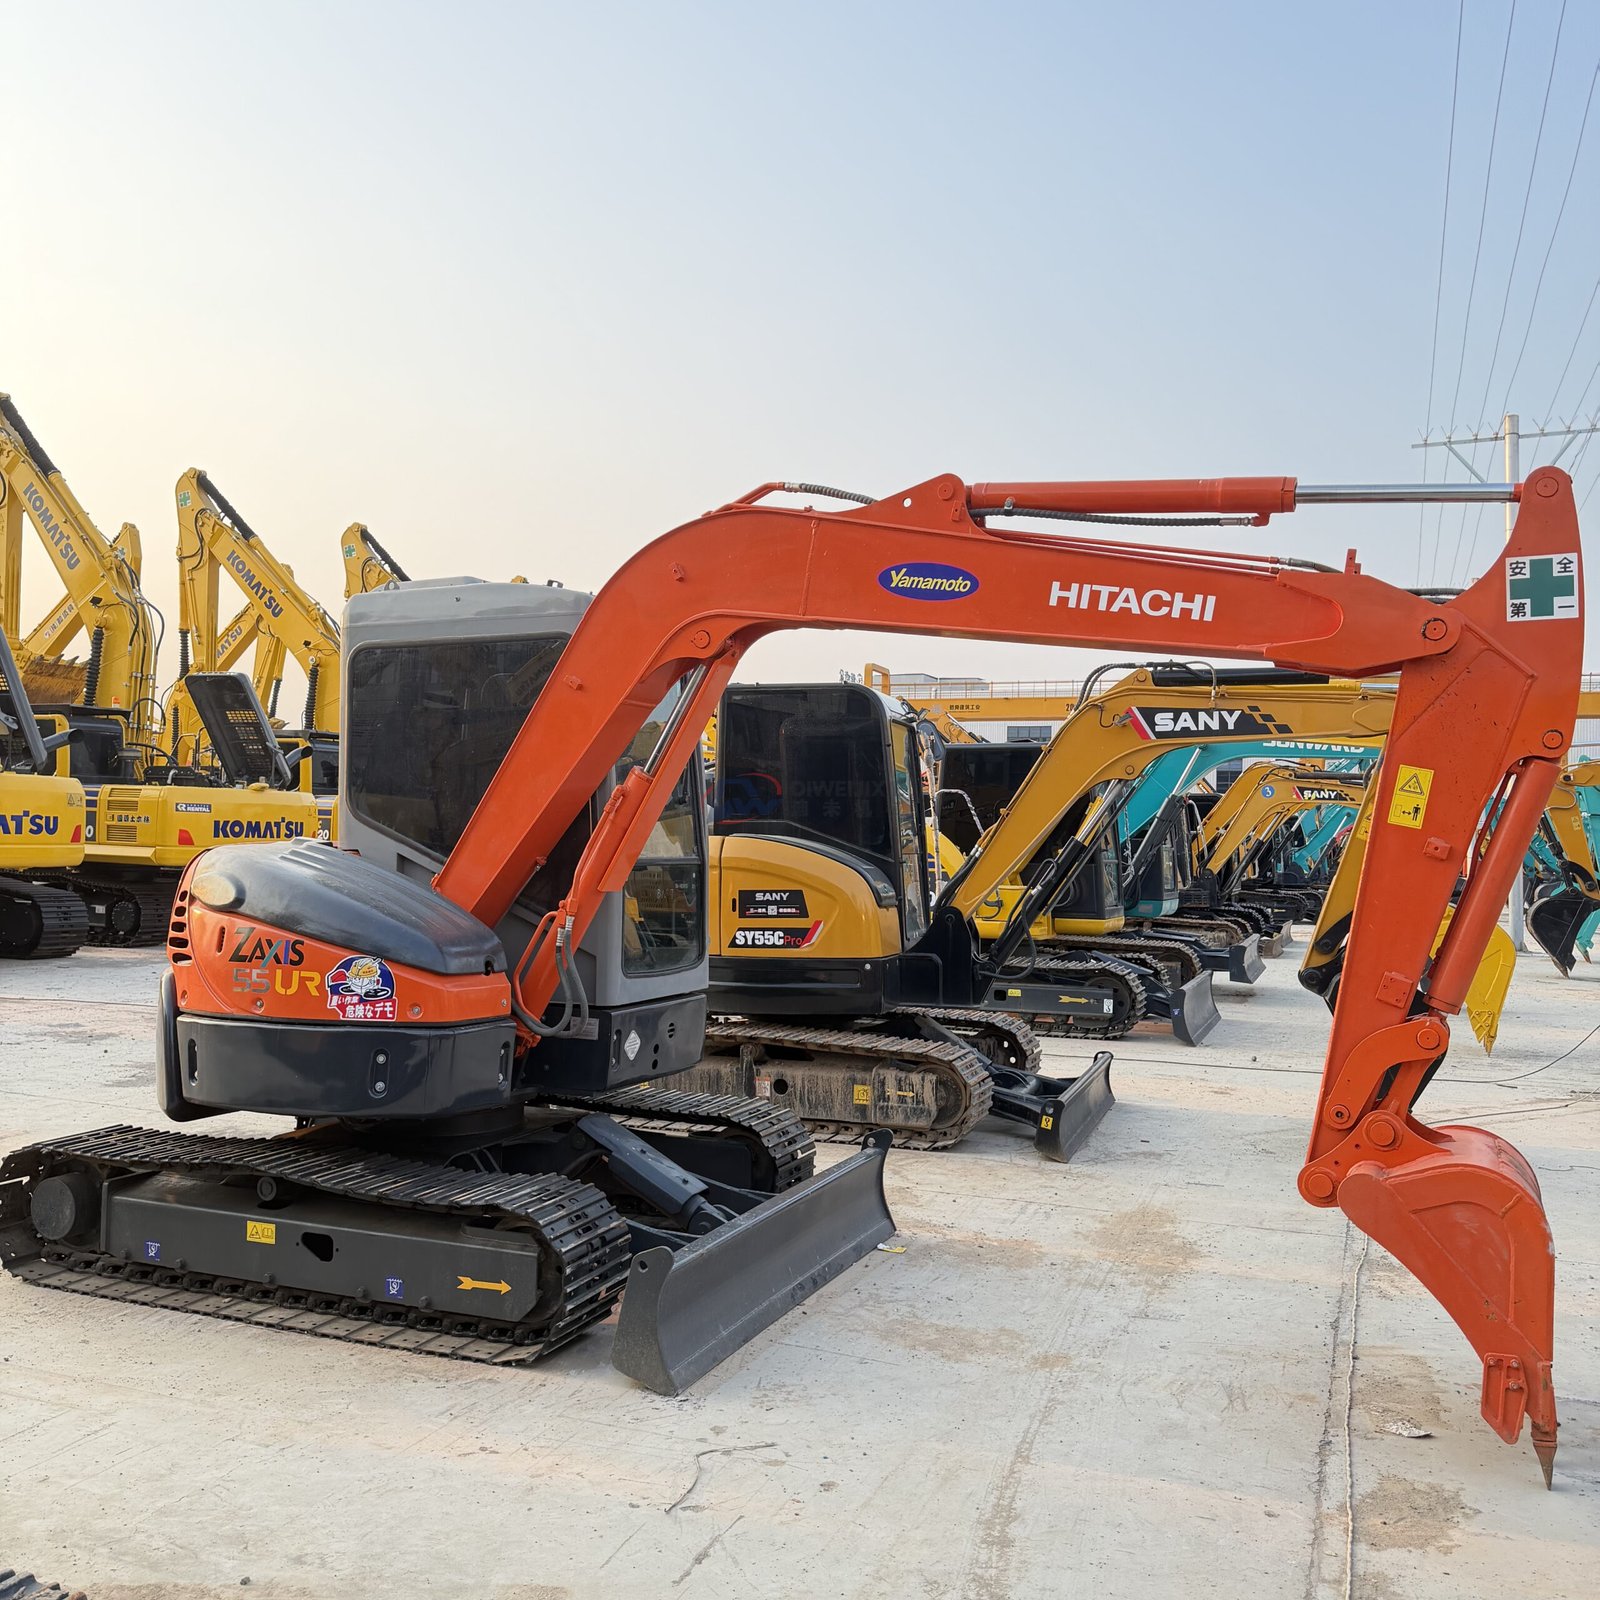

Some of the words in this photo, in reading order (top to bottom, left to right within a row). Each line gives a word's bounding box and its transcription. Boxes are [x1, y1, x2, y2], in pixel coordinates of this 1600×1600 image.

[23, 482, 80, 570] KOMATSU
[226, 549, 284, 618] KOMATSU
[889, 568, 971, 593] Yamamoto
[1048, 581, 1217, 622] HITACHI
[1154, 710, 1242, 732] SANY
[1303, 790, 1338, 800] SANY
[213, 817, 304, 839] KOMATSU
[755, 892, 790, 901] SANY
[228, 927, 305, 968] ZAXIS
